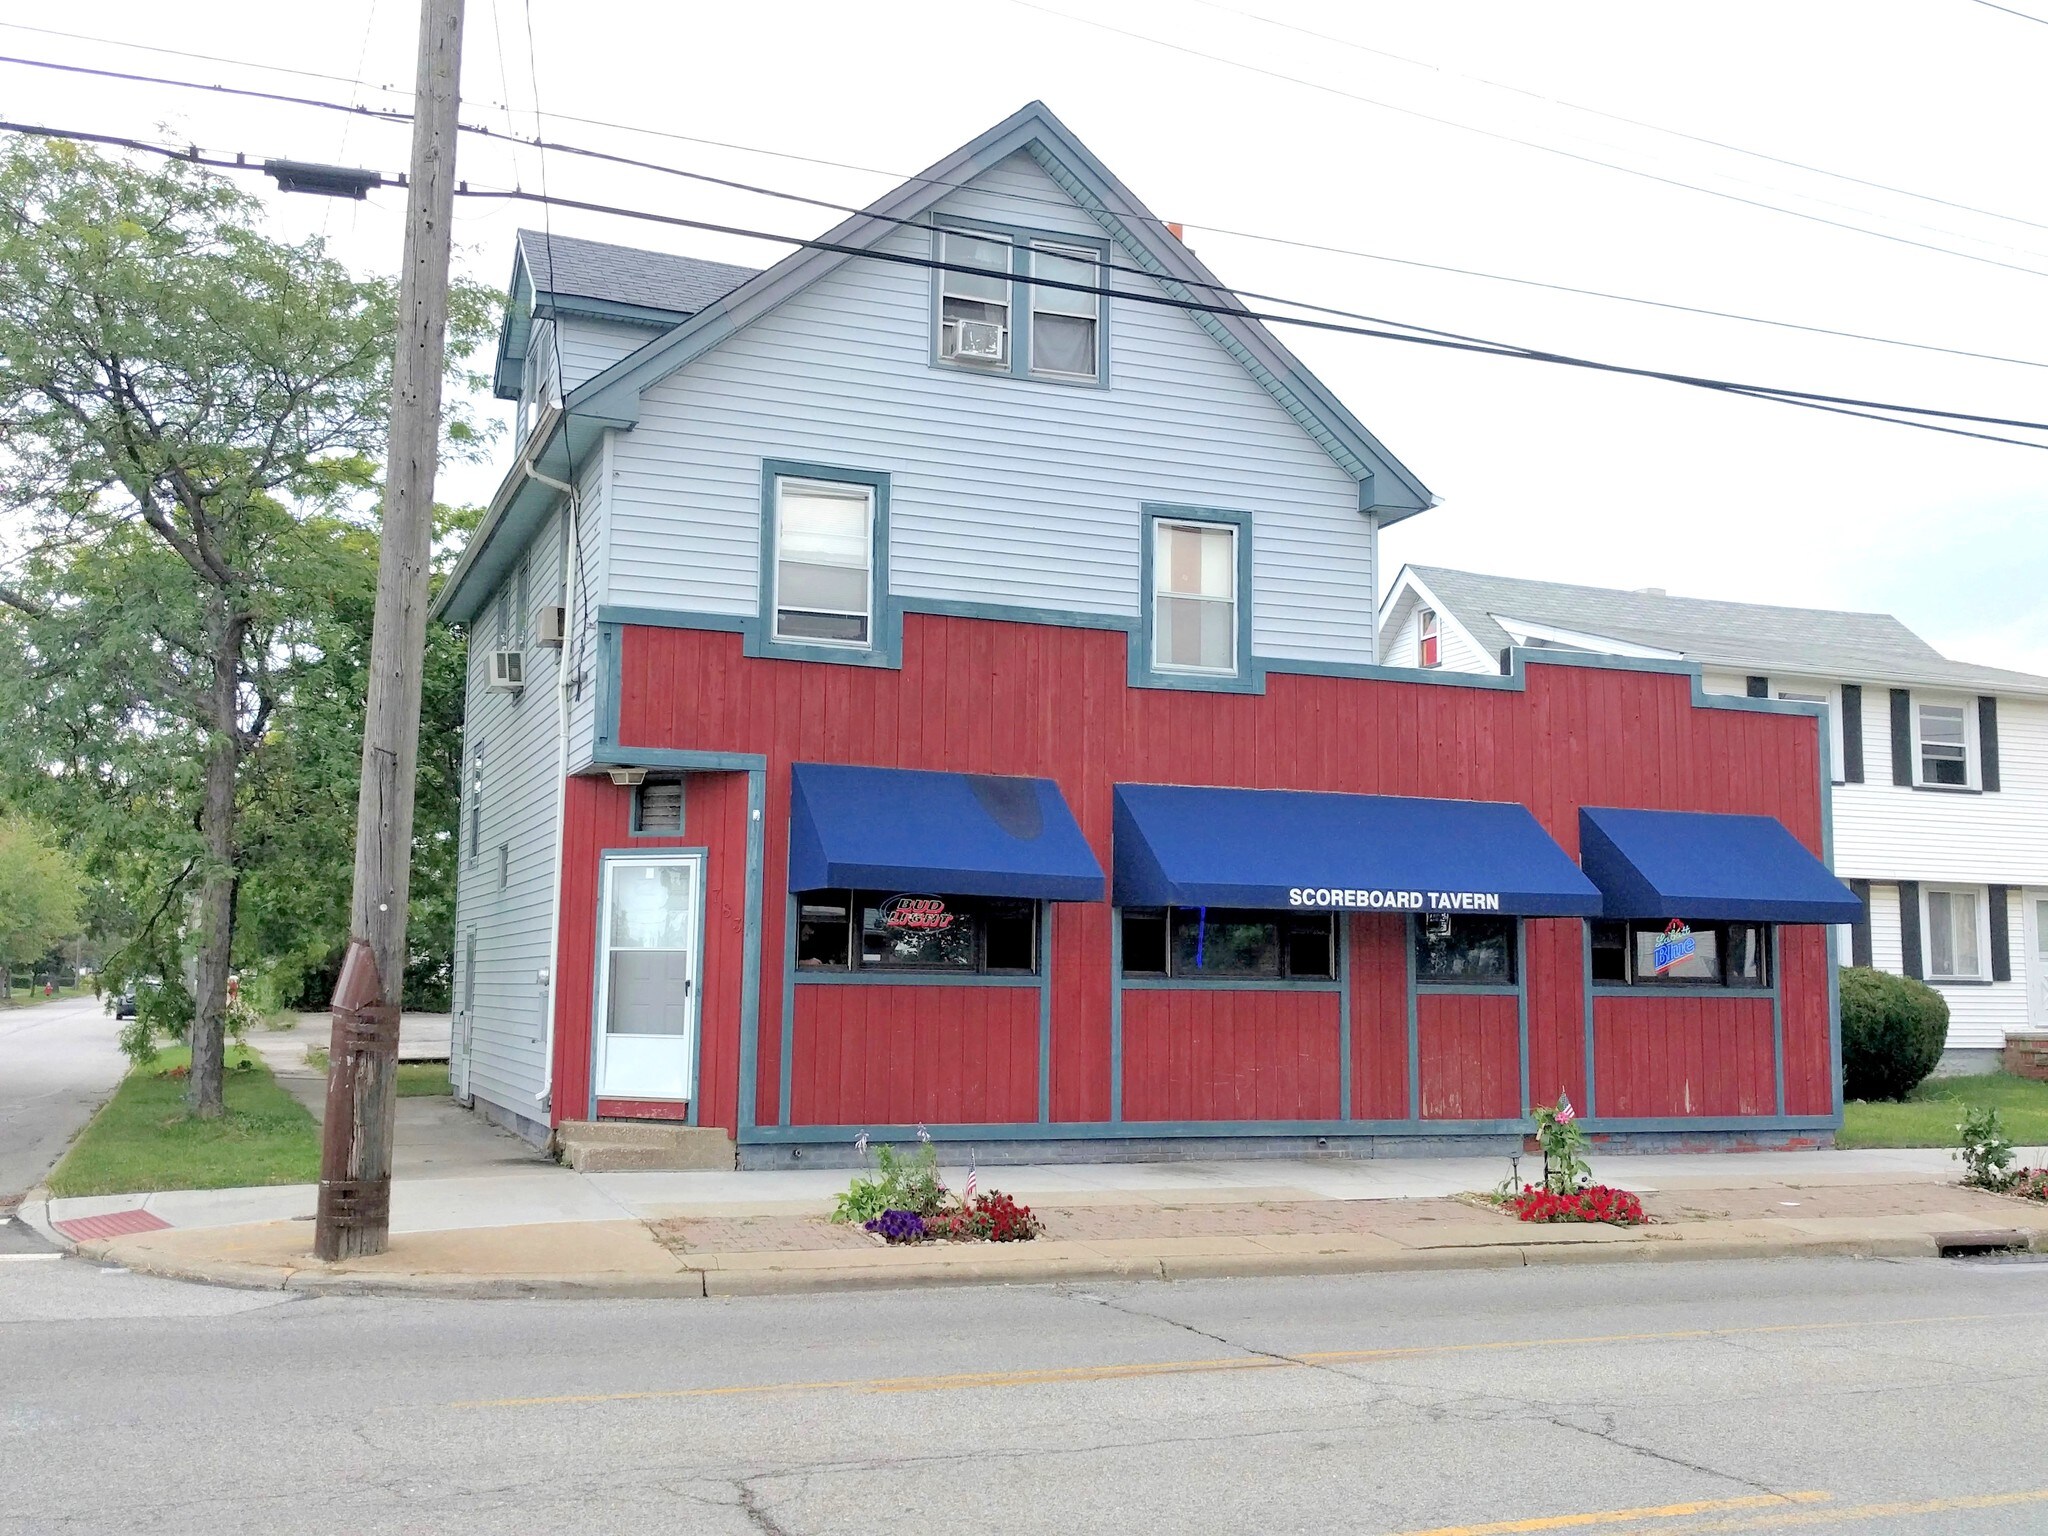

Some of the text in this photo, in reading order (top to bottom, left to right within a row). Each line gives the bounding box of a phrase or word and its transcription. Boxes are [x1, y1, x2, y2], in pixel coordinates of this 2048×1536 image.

[896, 898, 945, 914] BUD
[1289, 888, 1499, 911] SCOREBOARD TAVERN
[886, 911, 954, 928] LIGHT
[1655, 925, 1691, 948] Labatt
[1654, 937, 1696, 970] Blue
